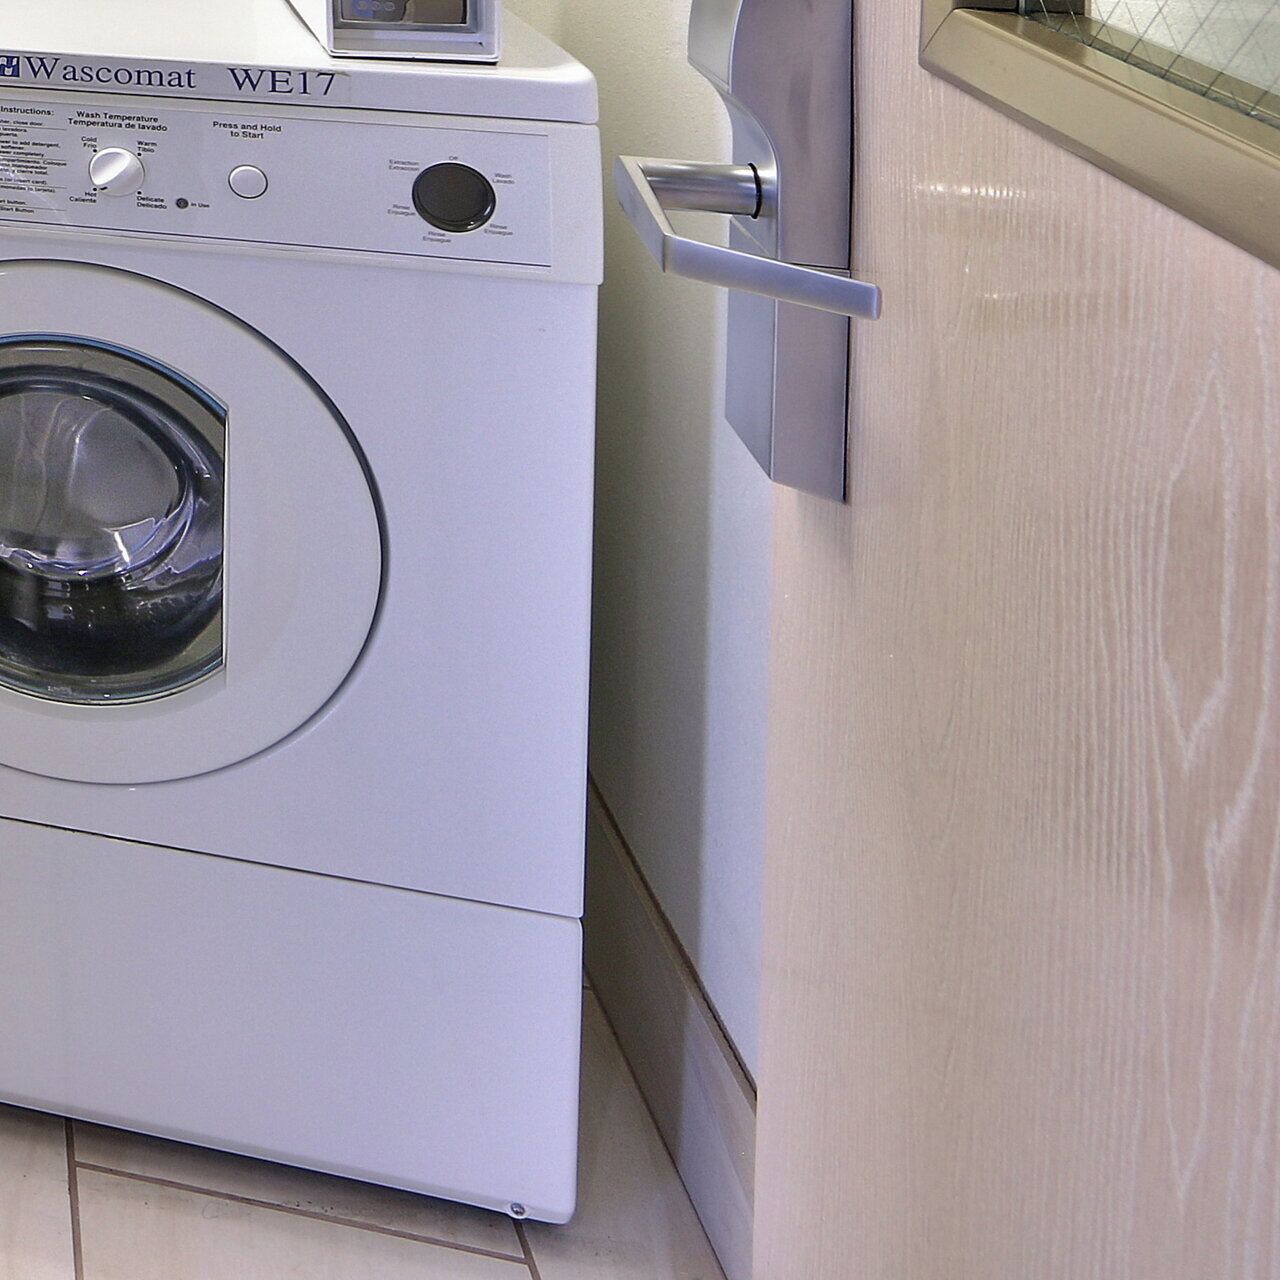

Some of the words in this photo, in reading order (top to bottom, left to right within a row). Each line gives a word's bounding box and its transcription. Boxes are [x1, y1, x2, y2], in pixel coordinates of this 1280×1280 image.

[24, 56, 197, 89] Wascomat
[227, 67, 336, 96] WE17
[0, 105, 55, 116] Instructions:
[76, 110, 101, 119] Wash
[103, 112, 159, 123] Temperature
[68, 118, 123, 128] Temperatura
[138, 123, 168, 132] lavado
[212, 121, 238, 129] Press
[260, 124, 282, 132] Hold
[242, 130, 264, 139] Start
[137, 195, 165, 203] Delicate
